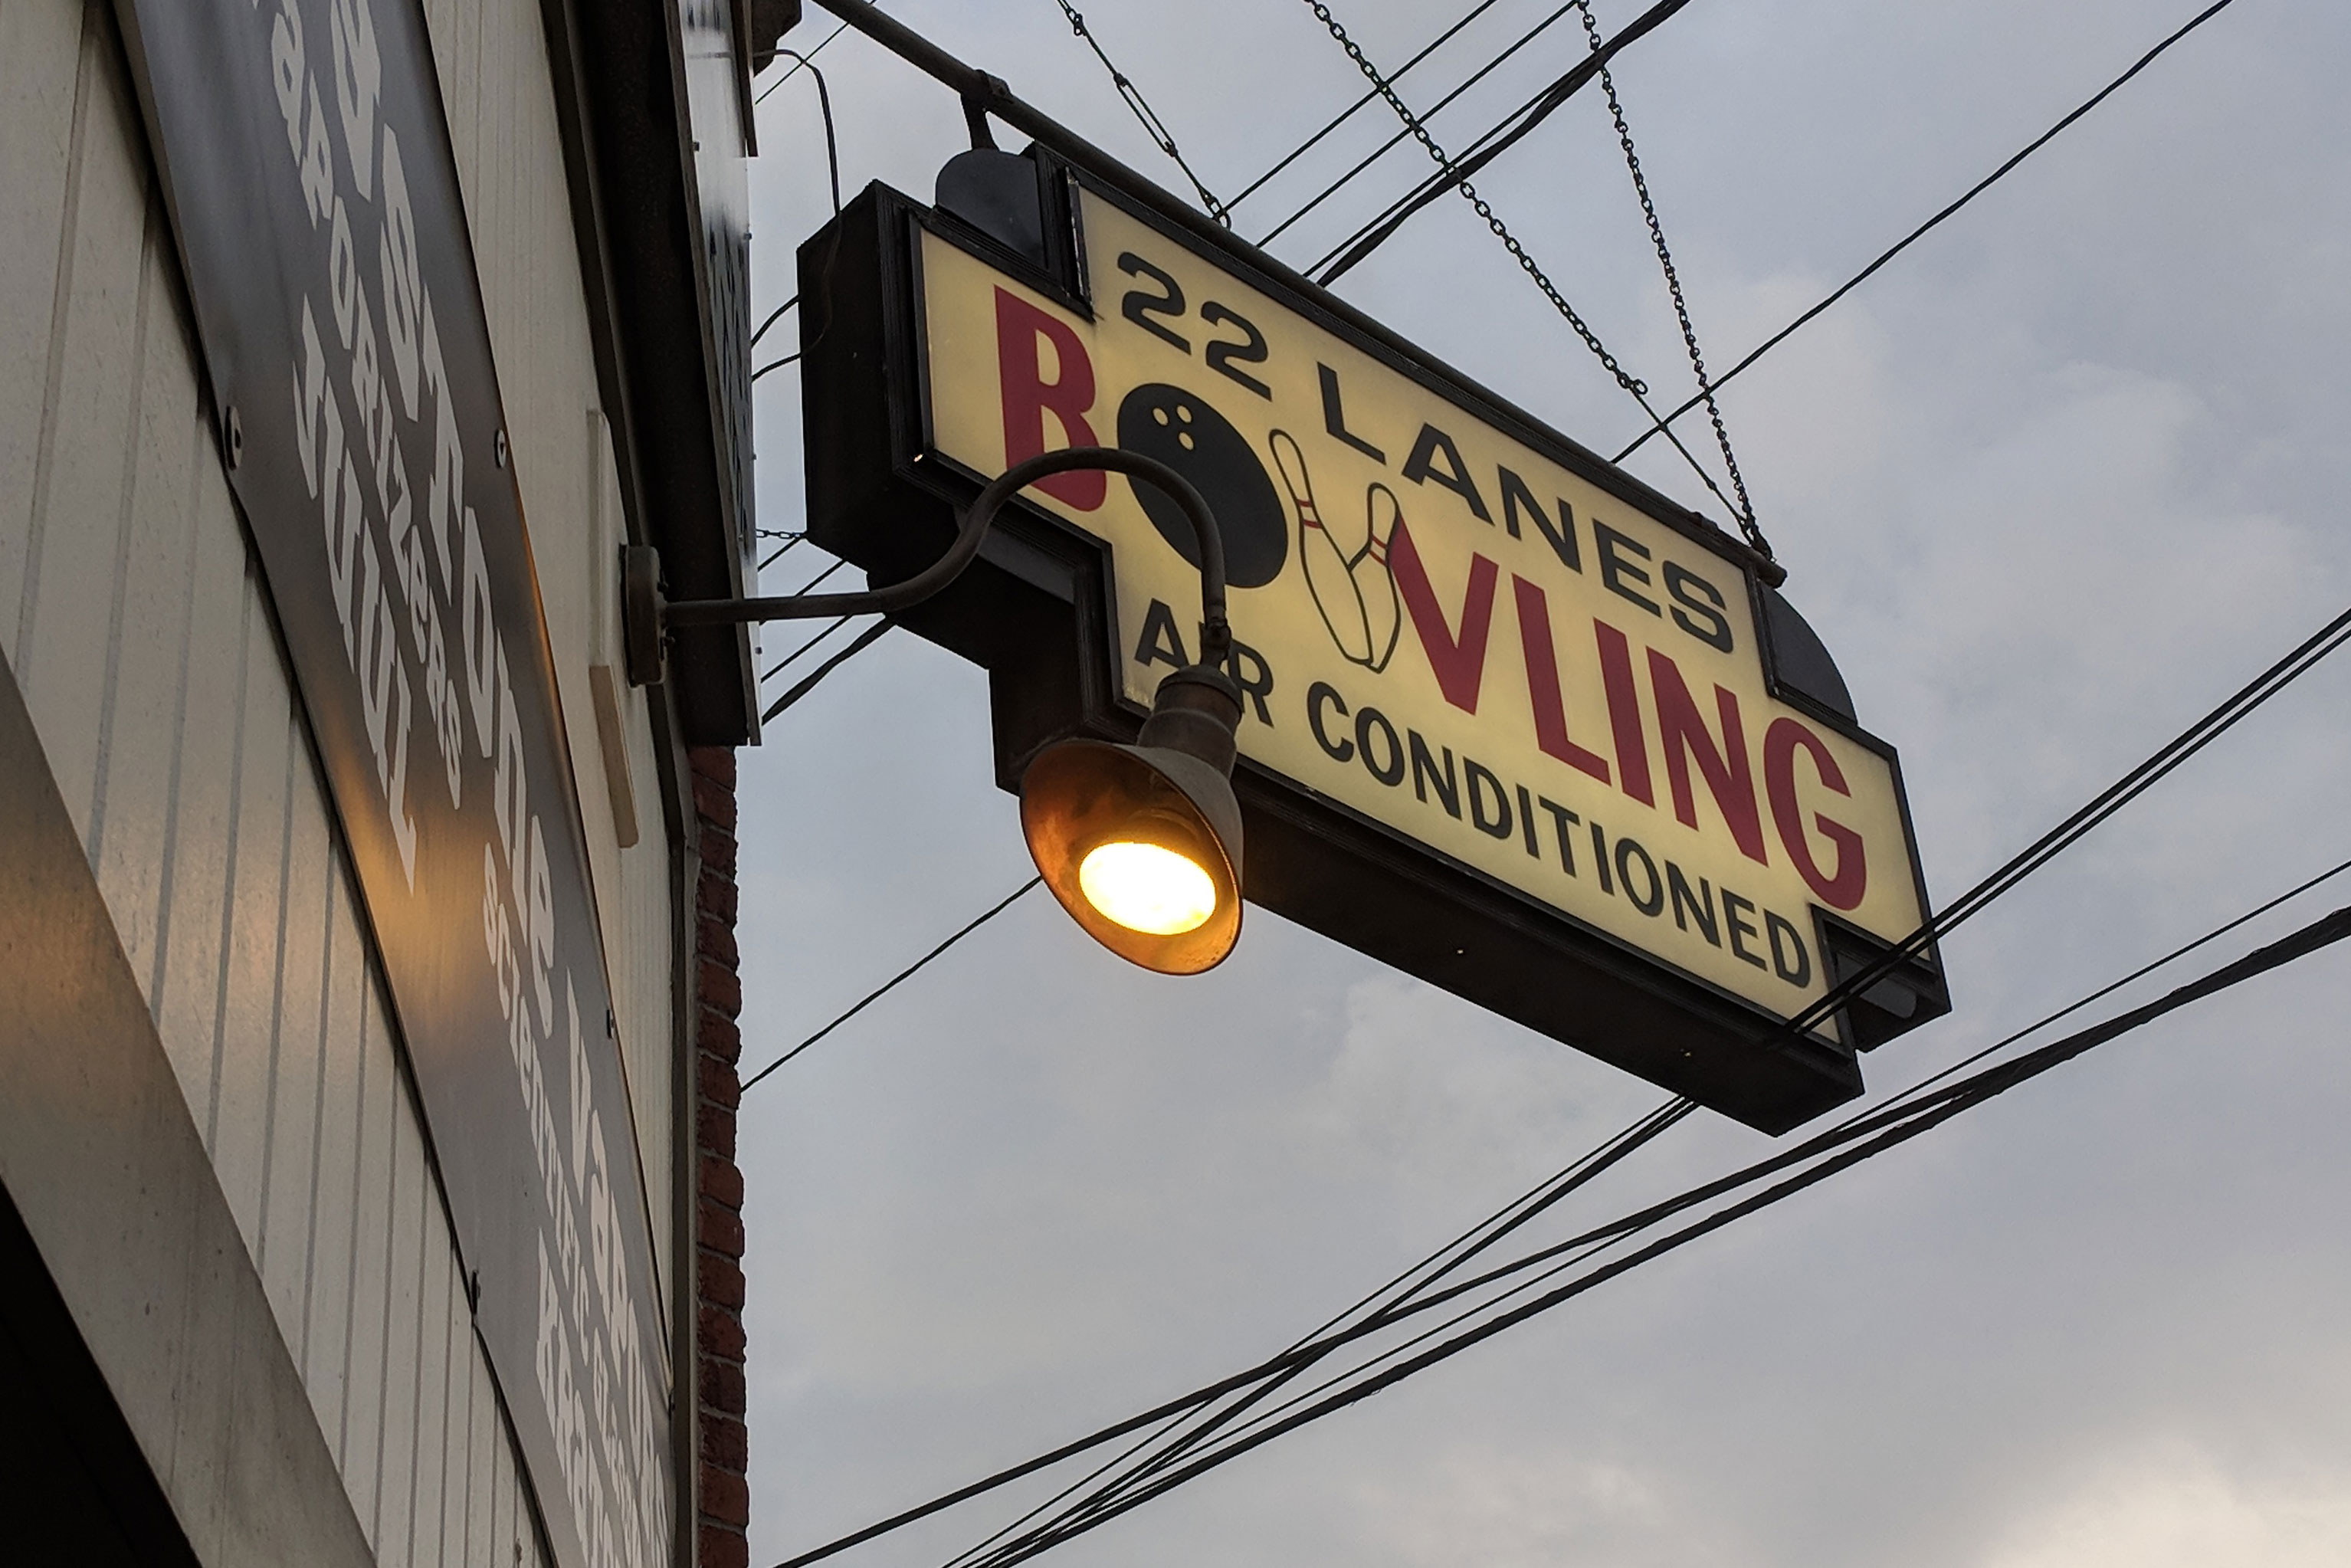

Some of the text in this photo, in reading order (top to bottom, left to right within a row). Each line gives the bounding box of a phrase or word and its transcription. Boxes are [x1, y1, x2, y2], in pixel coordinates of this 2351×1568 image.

[252, 0, 463, 810] APORIZERS
[482, 841, 589, 1366] SCIENTIFIC
[292, 292, 418, 899] JUUL
[1116, 251, 1734, 654] 22 LANES
[1134, 597, 1812, 989] AR CONDITIONED
